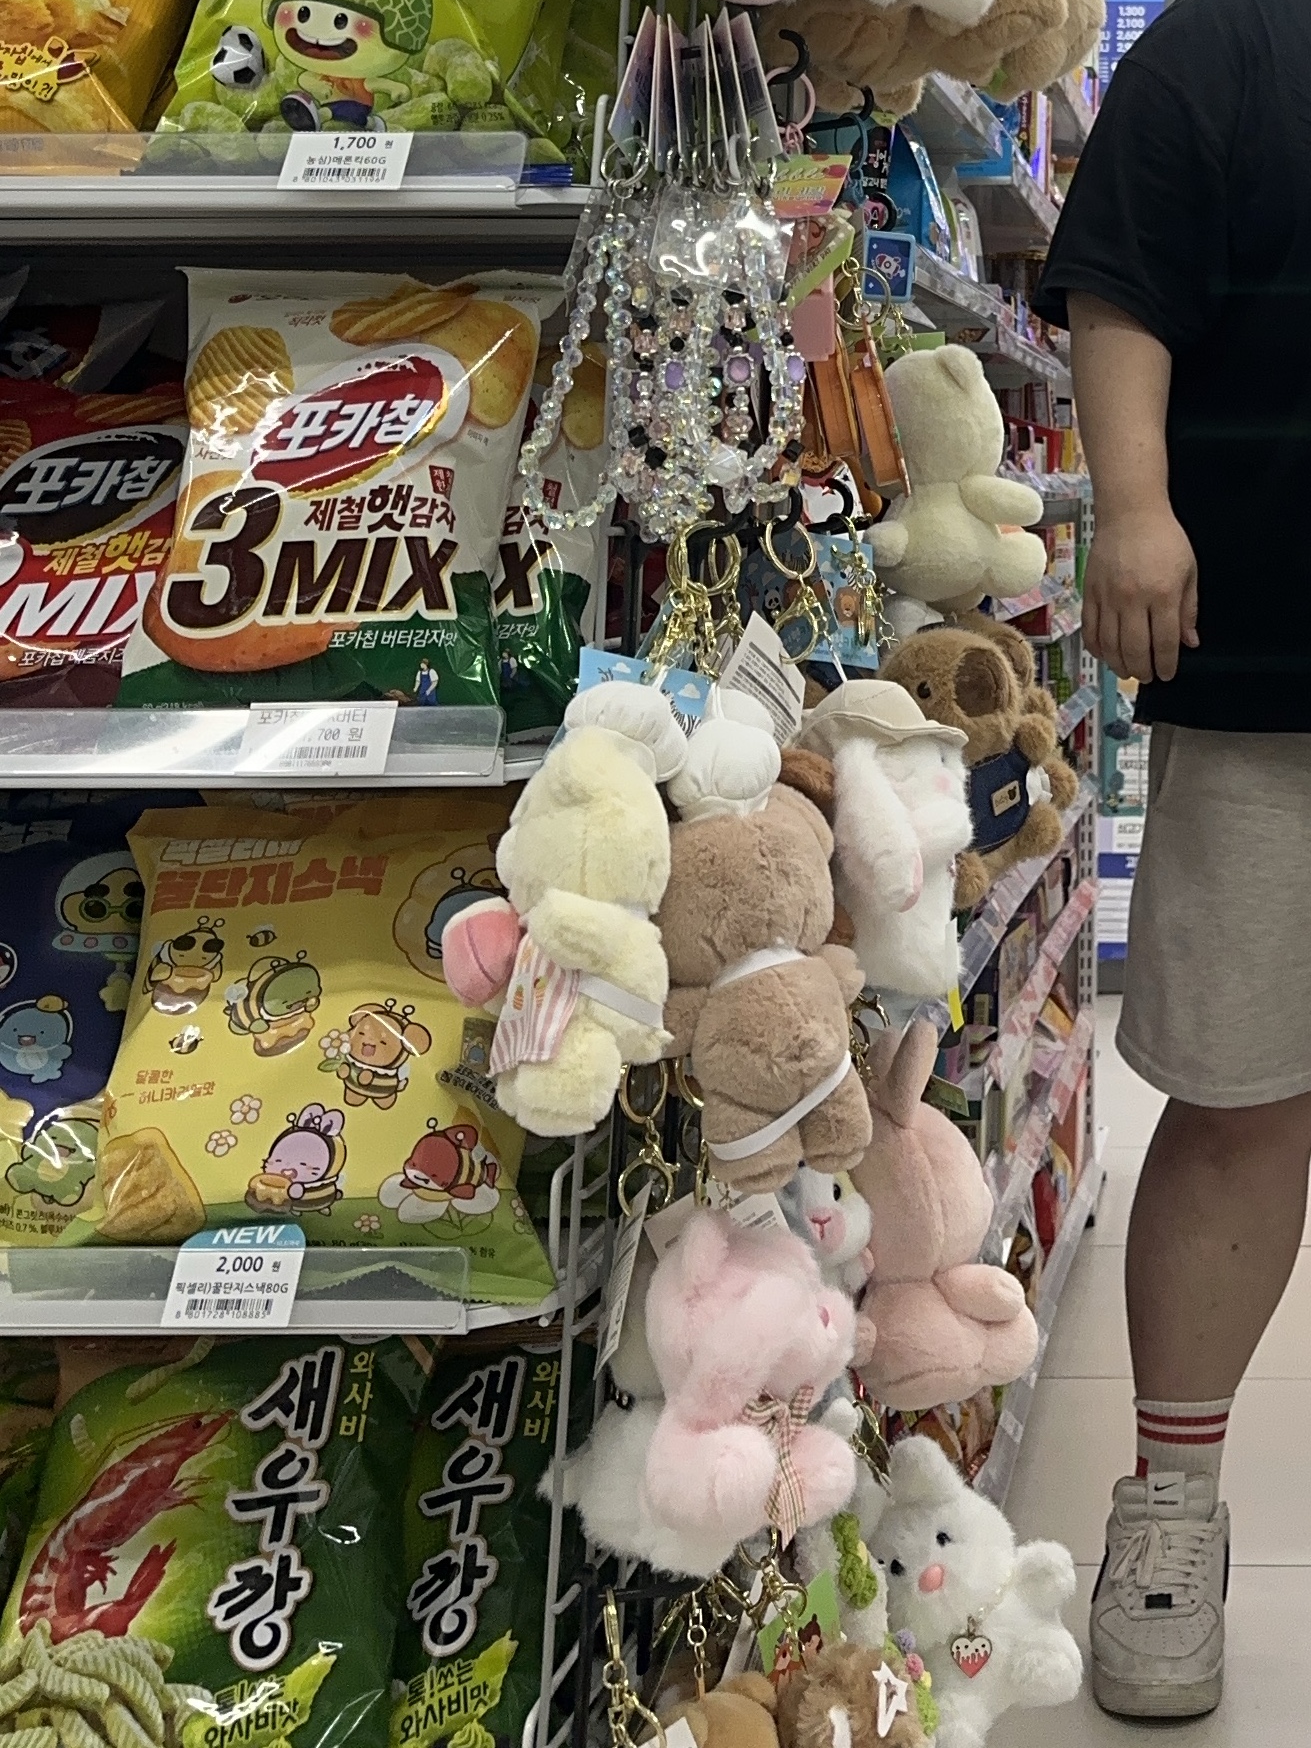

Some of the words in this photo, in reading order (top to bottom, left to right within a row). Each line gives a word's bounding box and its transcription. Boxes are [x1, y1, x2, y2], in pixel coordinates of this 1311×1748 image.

[333, 136, 377, 150] 1,700
[253, 394, 436, 461] 포카칩
[1, 456, 172, 515] 포카칩
[43, 530, 172, 576] 제철햇감
[168, 487, 458, 629] 3MIX
[18, 649, 66, 667] 포카칩
[329, 631, 379, 649] 포카칩
[380, 629, 458, 648] 버터감자맛
[347, 727, 364, 742] 원
[151, 855, 390, 916] 꿀단지스낵
[135, 1068, 174, 1084] 달콤한
[211, 1224, 286, 1245] NEW
[175, 1281, 290, 1295] 픽셀리)꿀단지스낵80G
[216, 1256, 264, 1275] 2,000
[272, 1261, 282, 1272] 원
[338, 1351, 375, 1443] 와사비
[524, 1360, 562, 1444] 와사비
[210, 1347, 340, 1665] 새우깡
[409, 1355, 524, 1656] 새우깡
[407, 1658, 475, 1706] 톡!쏘는
[400, 1680, 490, 1743] 와사비맛
